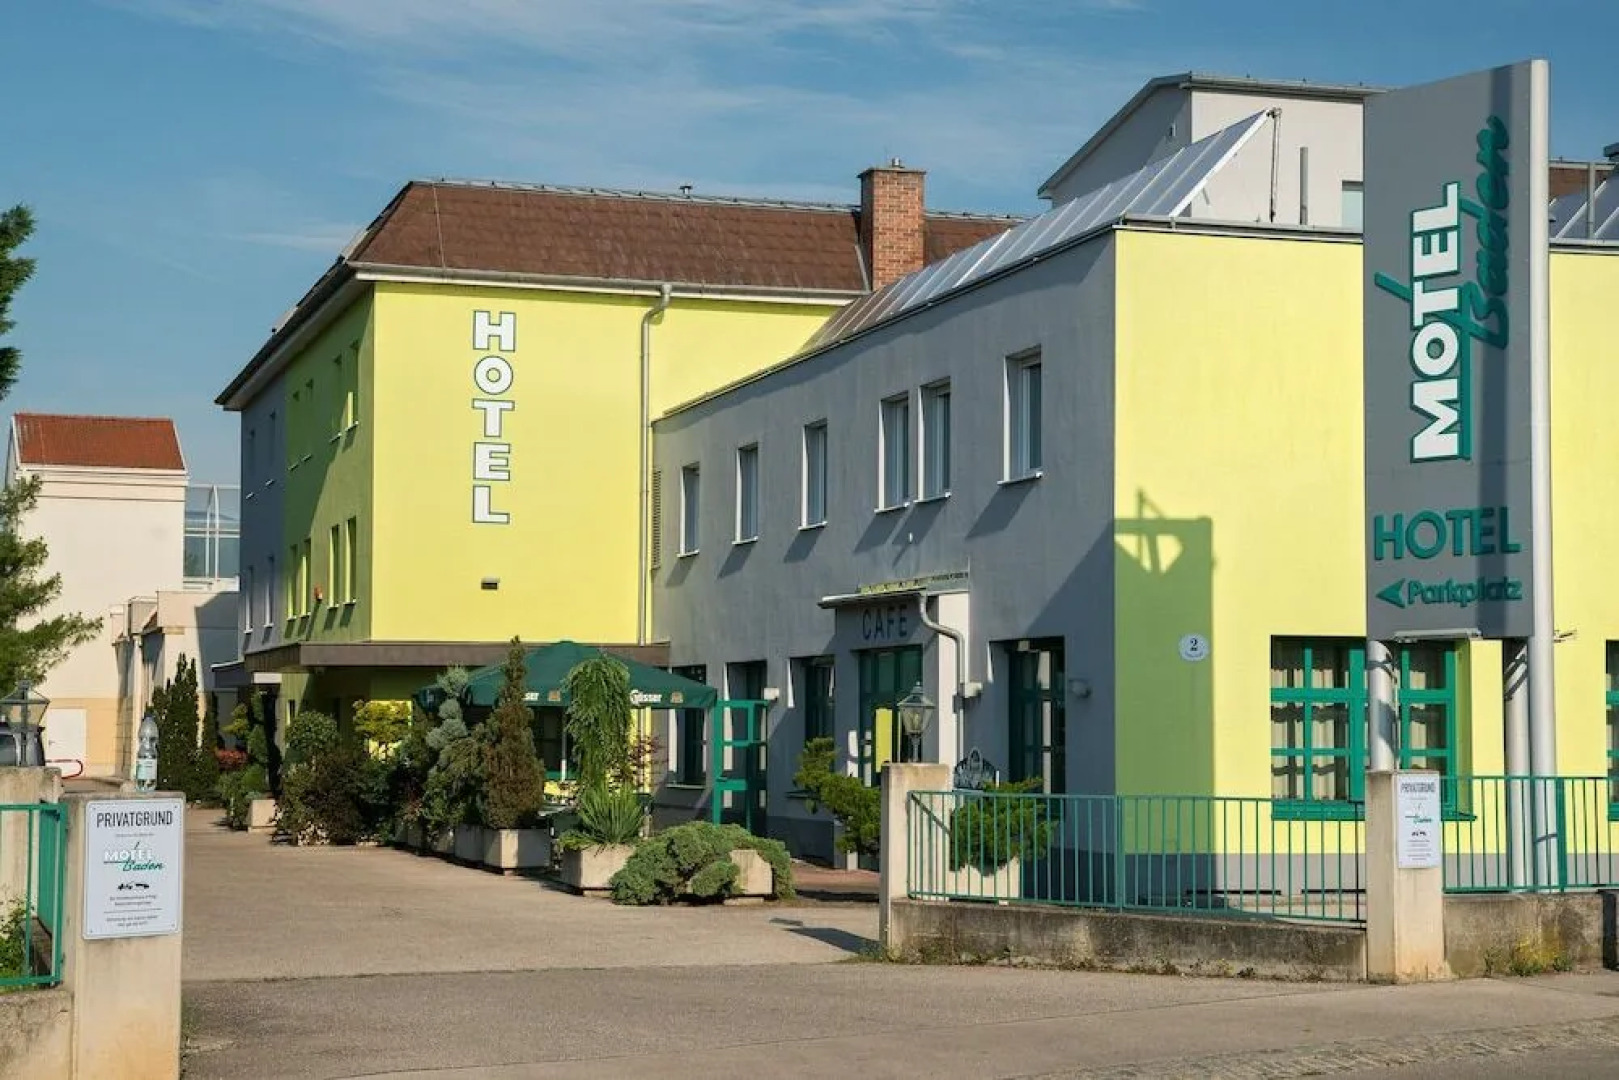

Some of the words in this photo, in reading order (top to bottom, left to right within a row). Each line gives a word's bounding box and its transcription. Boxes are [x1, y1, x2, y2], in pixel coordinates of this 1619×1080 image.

[1410, 181, 1461, 463] MOTEL
[472, 310, 516, 525] HOTEL
[1374, 506, 1521, 561] HOTEL
[1408, 576, 1523, 608] Parkplatz
[1190, 637, 1198, 652] 2
[96, 810, 174, 828] PRIVATGRUND
[104, 849, 153, 861] MOTEL
